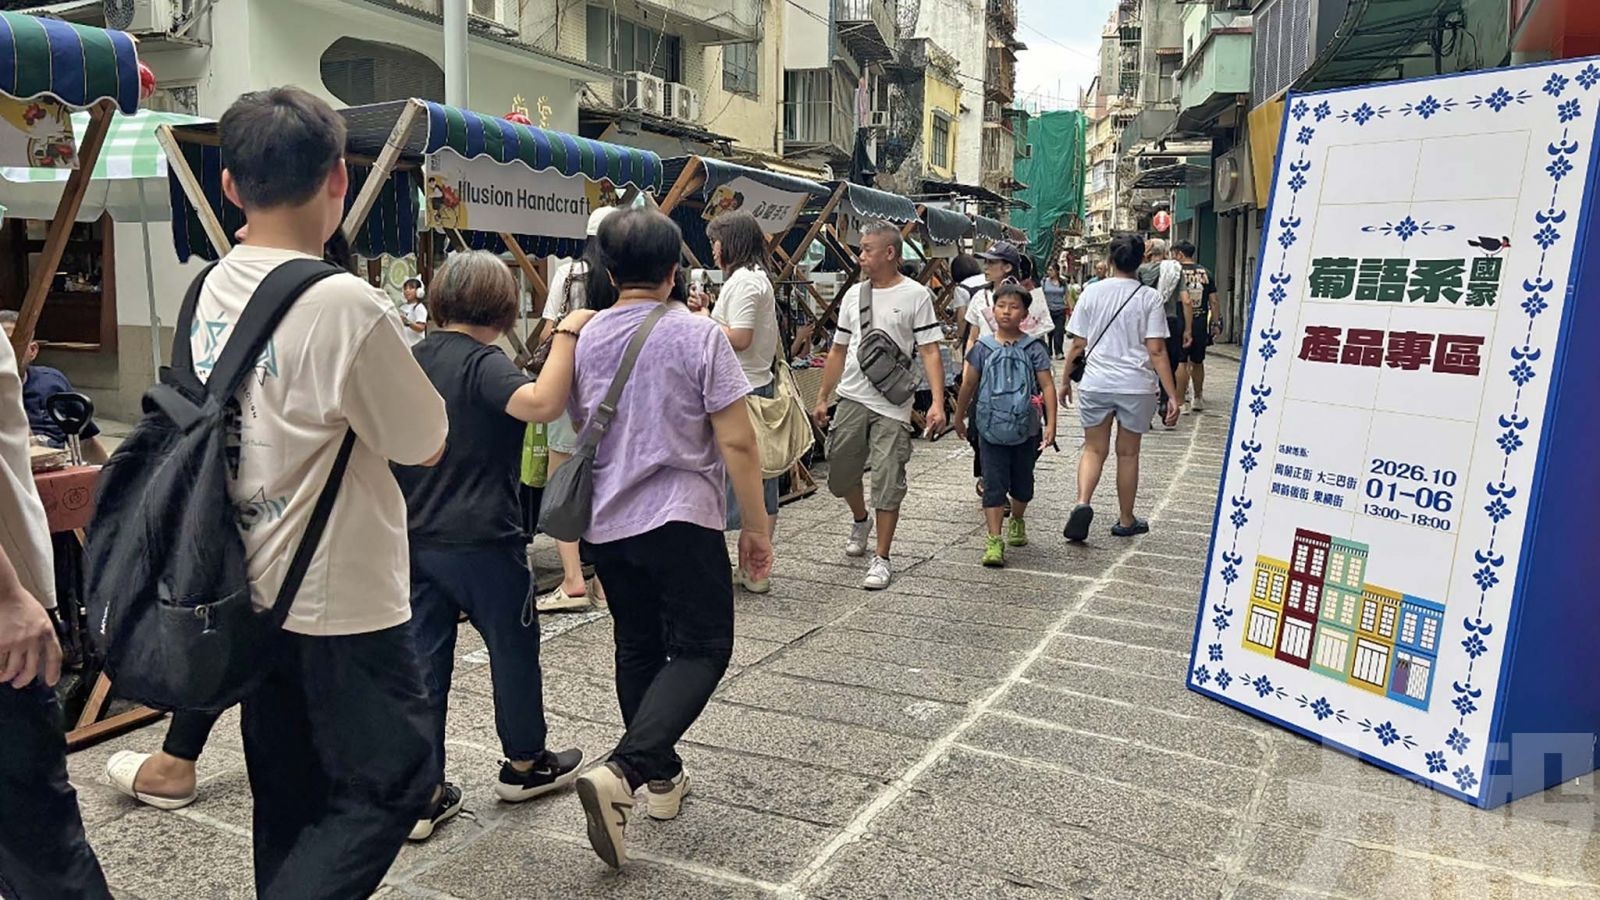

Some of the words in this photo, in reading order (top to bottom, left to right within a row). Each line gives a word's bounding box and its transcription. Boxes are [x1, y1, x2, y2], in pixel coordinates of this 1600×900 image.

[458, 180, 513, 207] Illusion
[517, 188, 592, 215] Handcraft
[1298, 326, 1485, 376] 產品專區
[1316, 471, 1358, 490] 大三巴街
[1369, 458, 1457, 487] 2026.10
[1366, 478, 1454, 512] 01-06
[1363, 503, 1451, 531] 13:00-18:00
